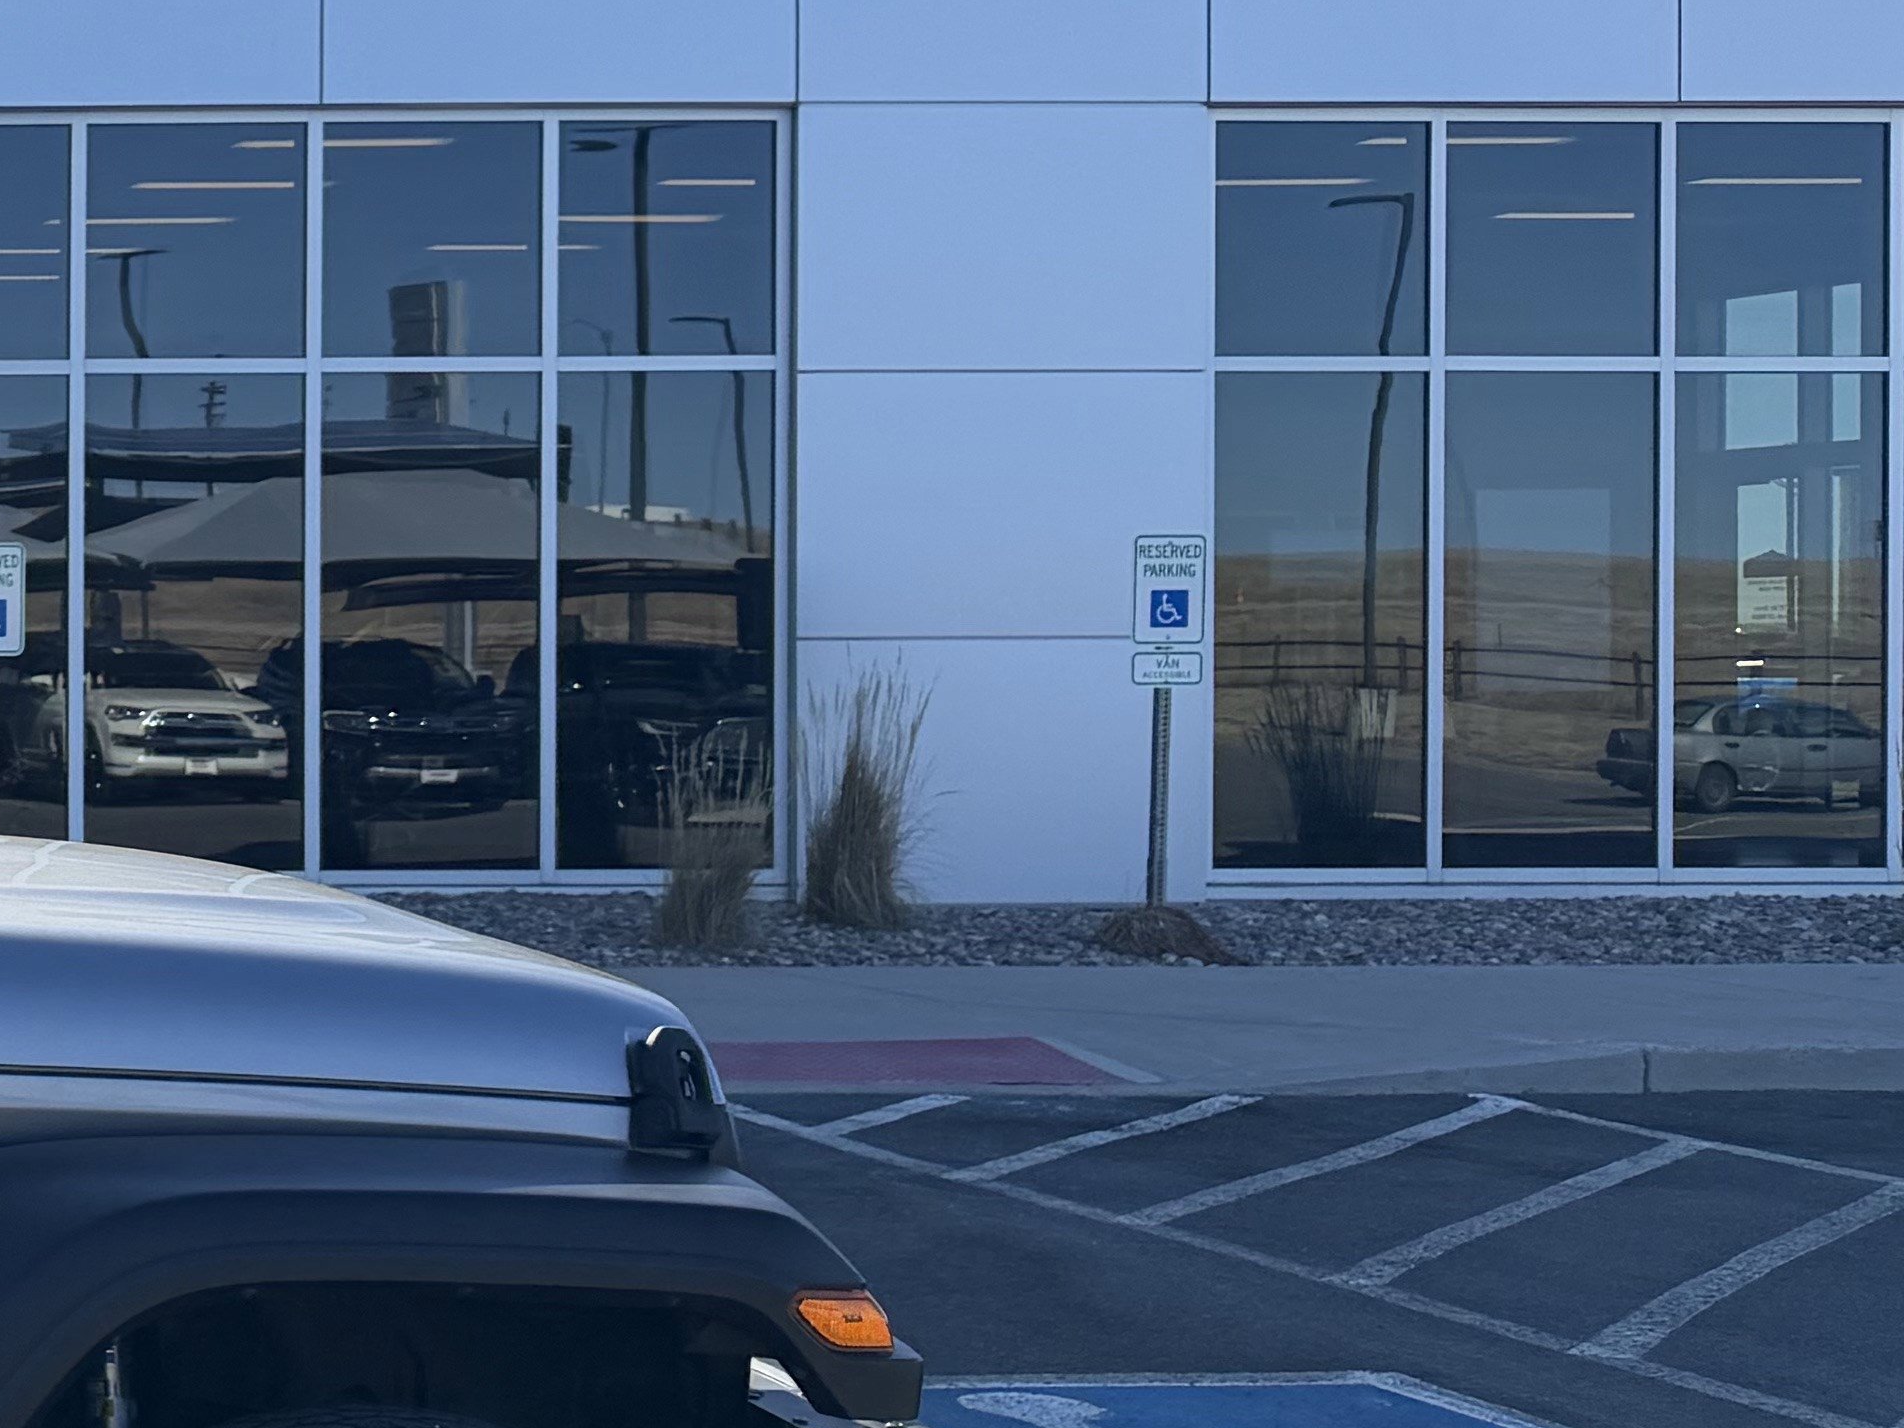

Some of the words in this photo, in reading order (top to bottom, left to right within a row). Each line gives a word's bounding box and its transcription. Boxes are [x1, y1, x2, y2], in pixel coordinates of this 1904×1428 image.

[1138, 543, 1202, 559] RESERVED
[1143, 563, 1197, 577] PARKING
[1156, 658, 1180, 669] VAN
